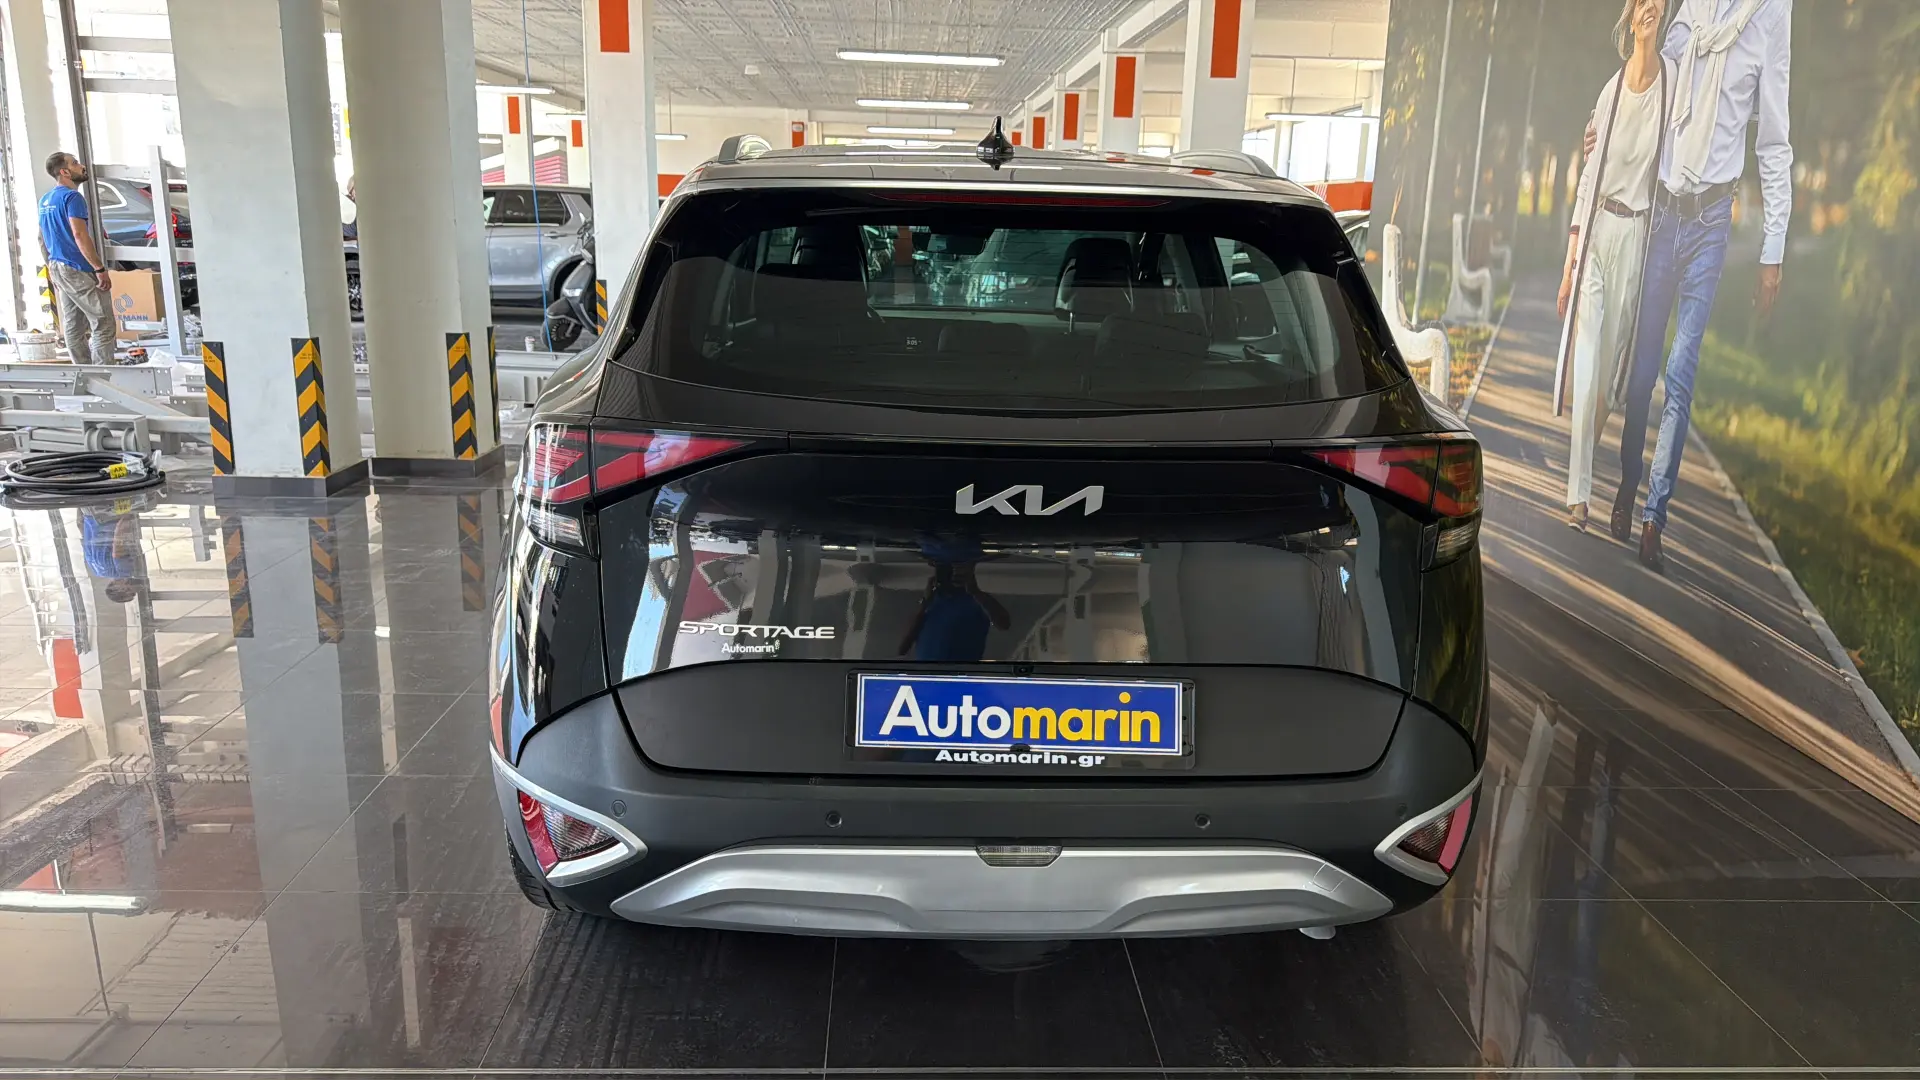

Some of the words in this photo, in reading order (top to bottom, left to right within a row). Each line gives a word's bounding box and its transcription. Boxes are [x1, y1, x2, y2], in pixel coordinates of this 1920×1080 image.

[955, 484, 1105, 516] KIA
[679, 621, 836, 639] SPORTAGE
[721, 642, 775, 653] Automarin
[879, 685, 1161, 743] Automarin
[935, 750, 1105, 767] Automarin.gr
